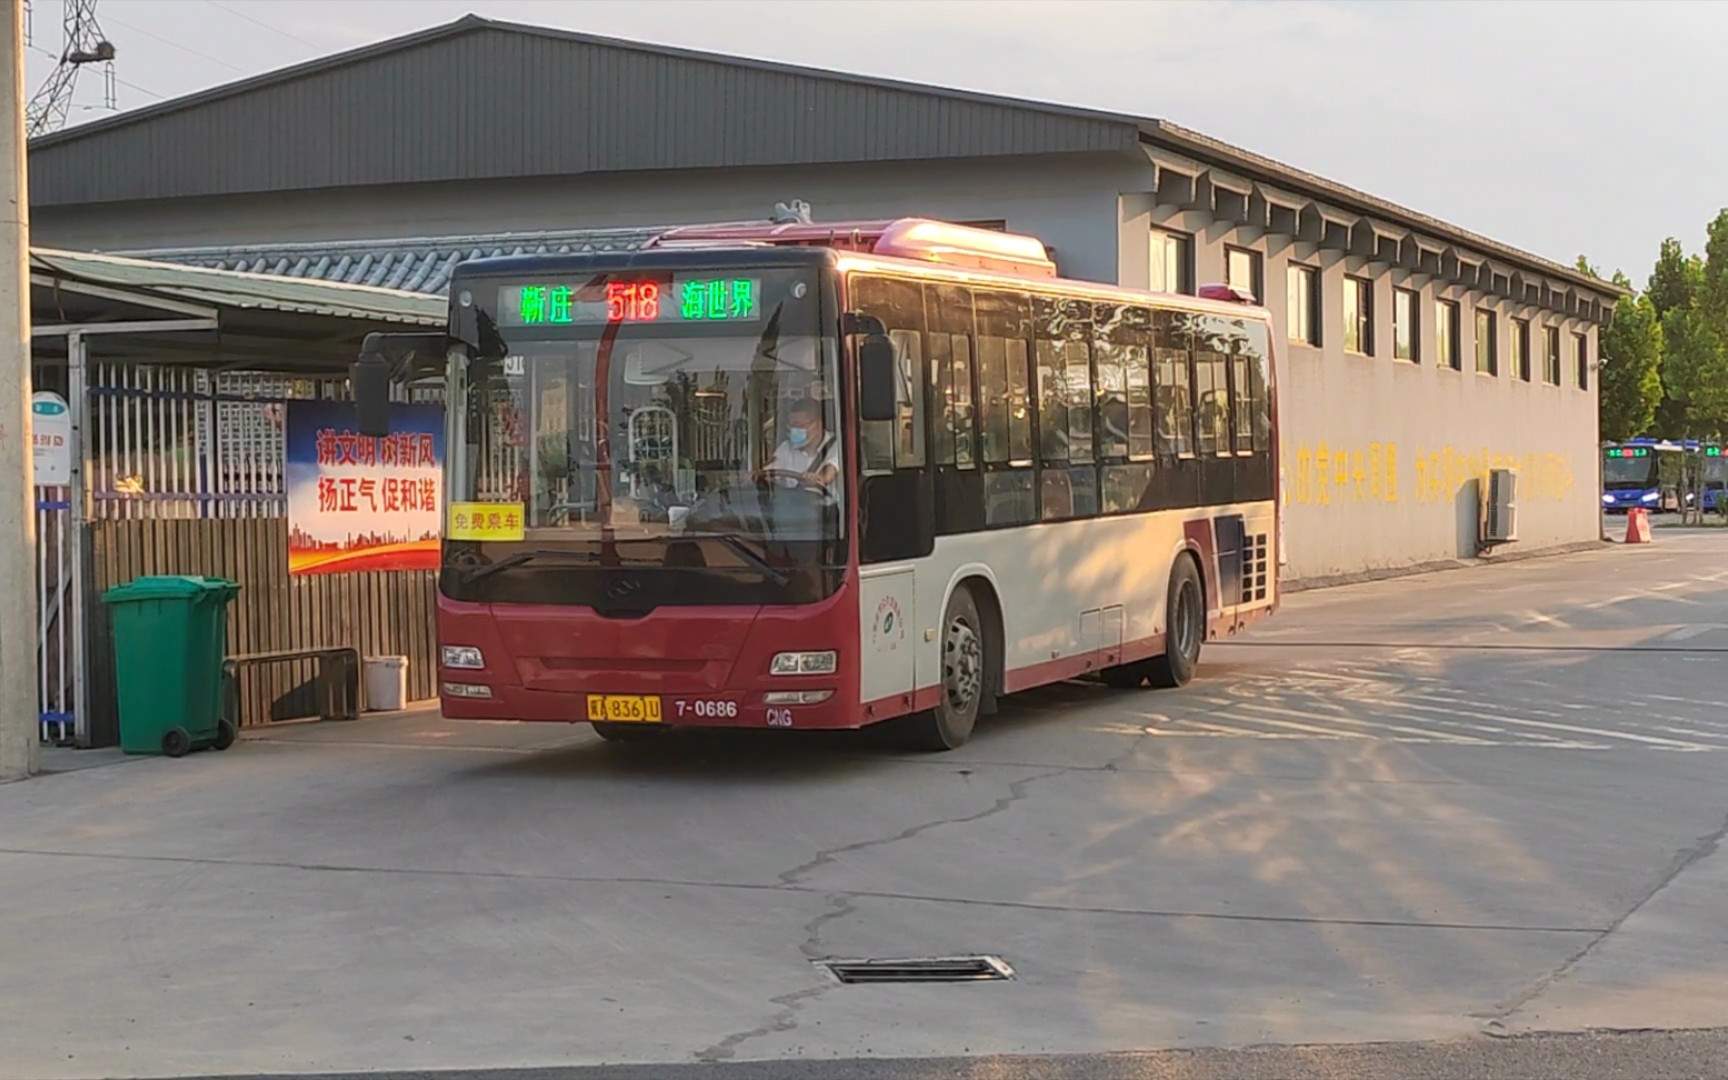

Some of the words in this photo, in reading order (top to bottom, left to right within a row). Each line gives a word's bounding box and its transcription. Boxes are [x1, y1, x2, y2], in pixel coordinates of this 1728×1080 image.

[607, 280, 660, 321] 518
[680, 278, 753, 320] 海世界
[316, 428, 377, 467] 讲文明
[381, 431, 436, 467] 树新风
[318, 476, 377, 513] 扬正气
[381, 476, 436, 513] 促和谐
[455, 512, 520, 531] 免费乘车
[675, 700, 738, 718] 7-0686
[766, 708, 793, 727] CNG
